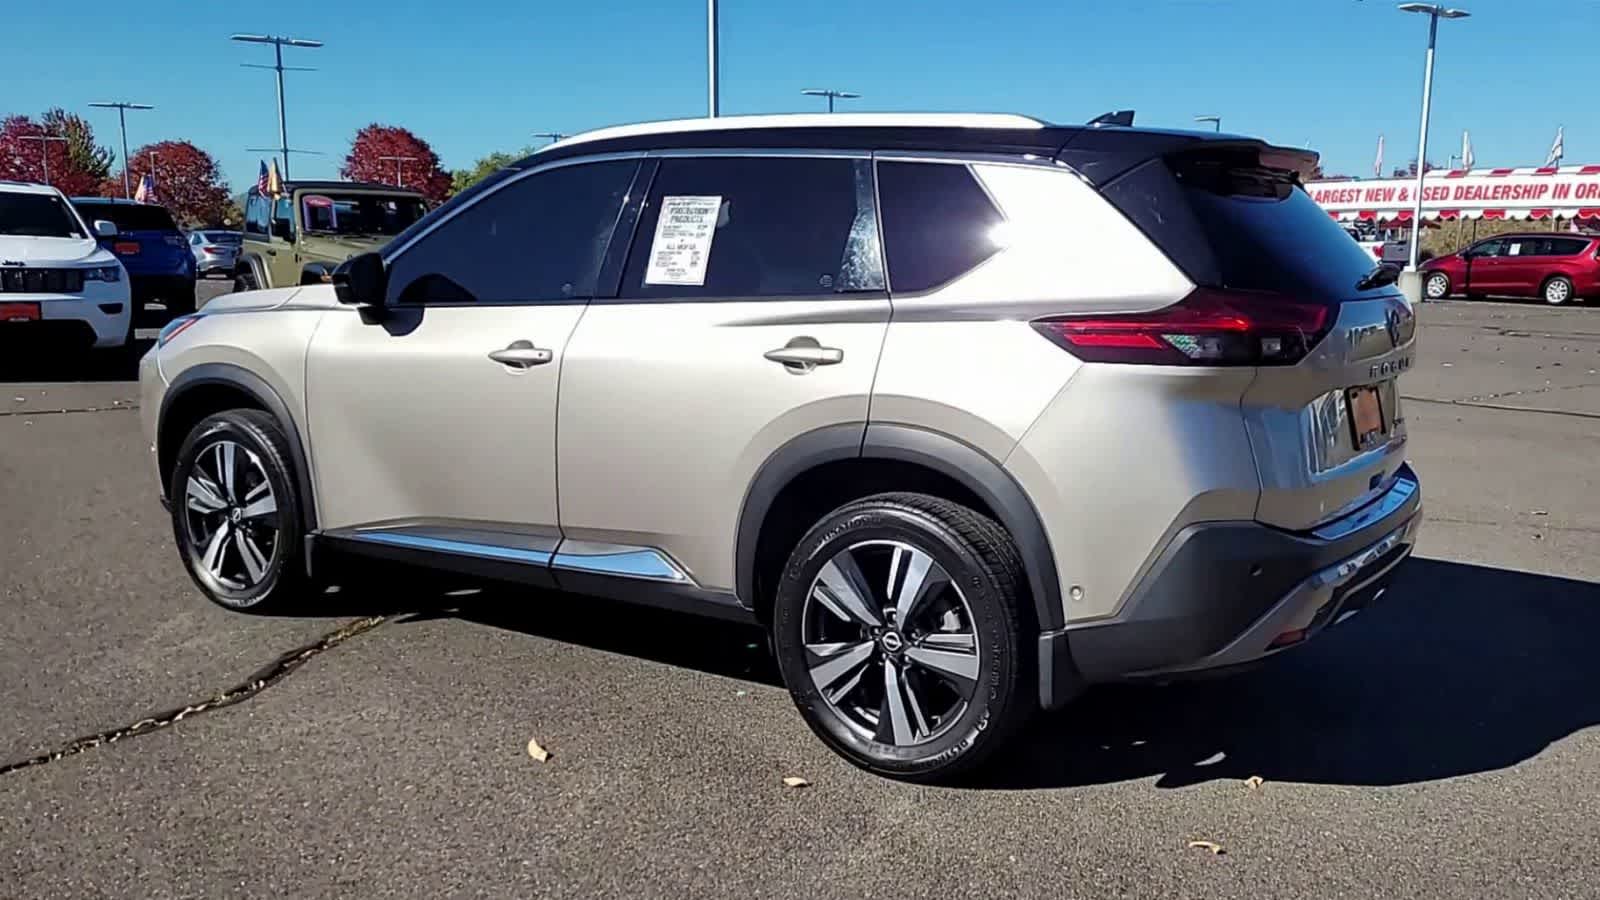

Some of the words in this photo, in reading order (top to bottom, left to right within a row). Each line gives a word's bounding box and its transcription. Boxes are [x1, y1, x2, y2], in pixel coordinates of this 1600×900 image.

[1310, 187, 1362, 204] ARGEST
[1364, 187, 1397, 203] NEW
[1398, 187, 1409, 202] &
[1453, 184, 1549, 201] DEALERSHIP
[1551, 183, 1571, 200] IN
[1575, 183, 1600, 199] OR
